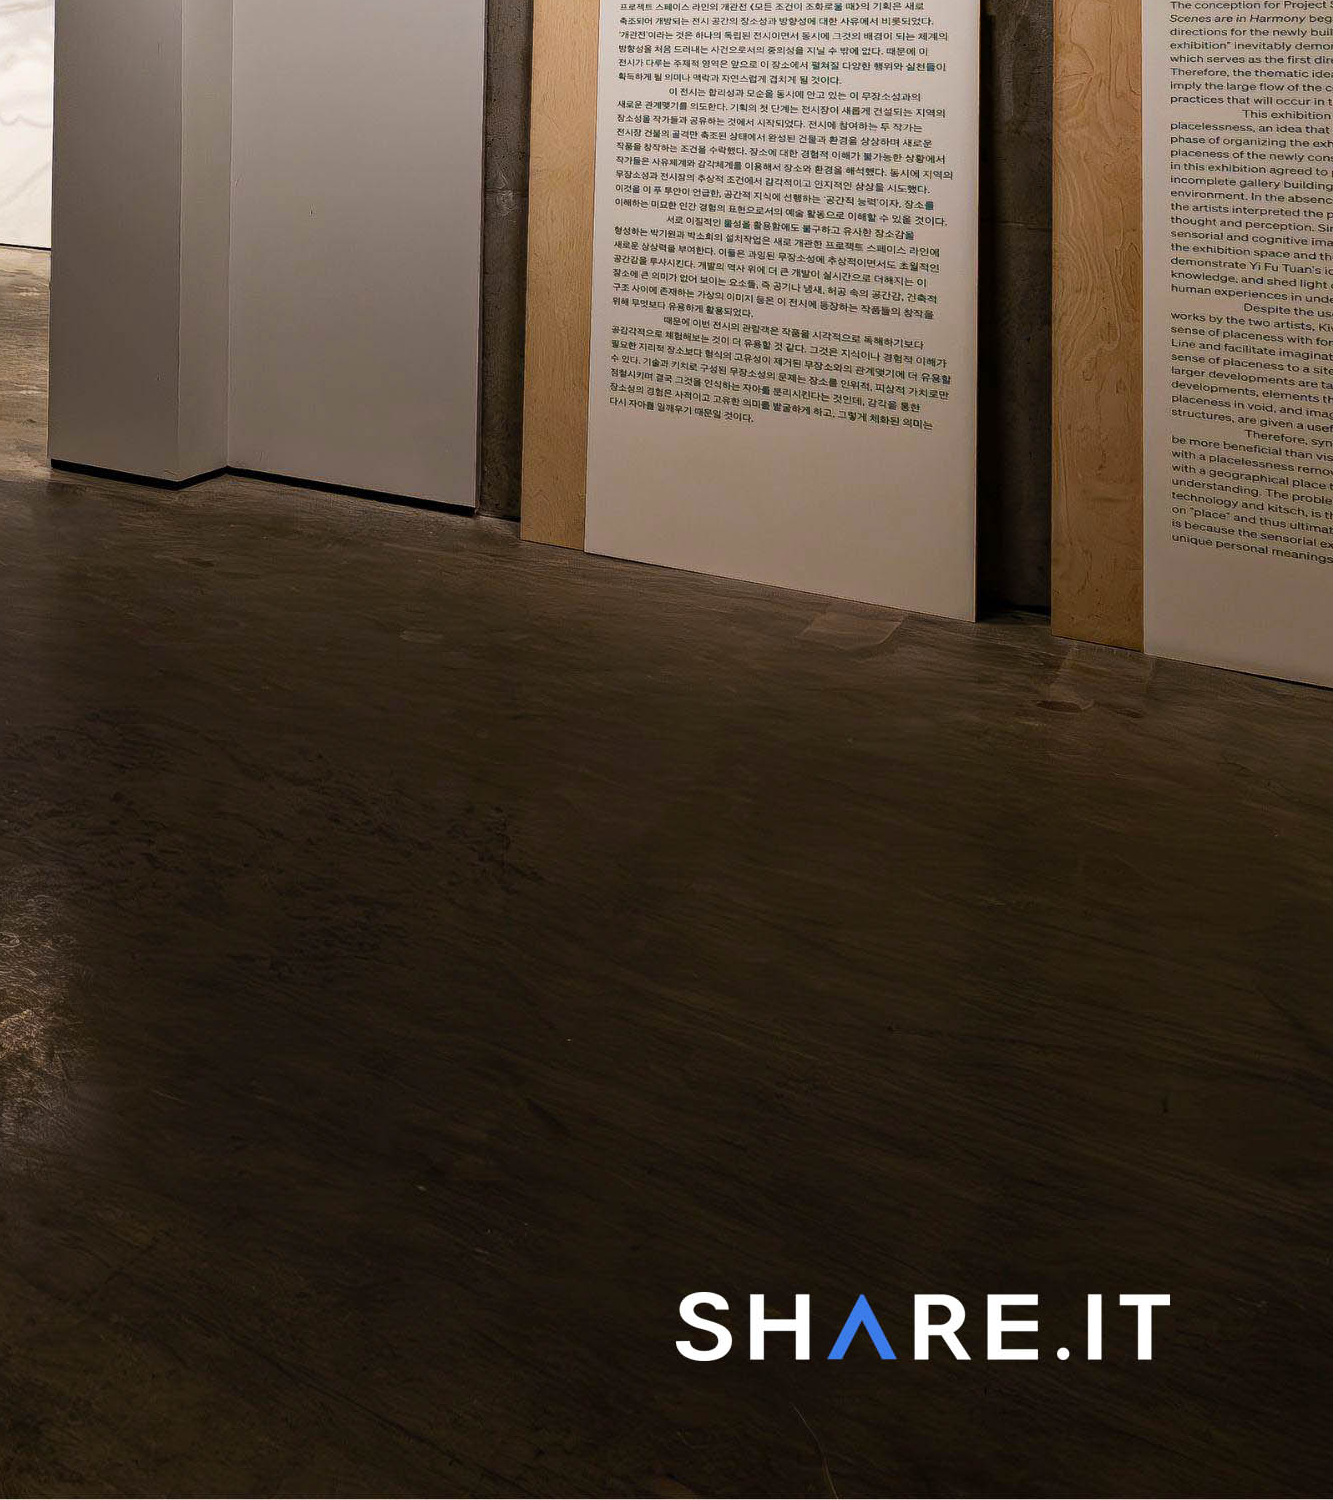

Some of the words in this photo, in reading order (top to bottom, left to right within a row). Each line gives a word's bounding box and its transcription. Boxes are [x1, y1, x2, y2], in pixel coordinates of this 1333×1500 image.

[619, 3, 652, 11] 프로젝트
[655, 3, 689, 11] 스페이스
[691, 3, 718, 11] 라인의
[720, 3, 747, 11] 개관전
[775, 3, 802, 11] 조건이
[872, 2, 902, 11] 기획은
[904, 2, 924, 11] 새로
[1170, 0, 1192, 9] The
[1194, 0, 1260, 11] conception
[1263, 0, 1280, 8] for
[1283, 0, 1327, 11] Project
[619, 17, 652, 25] 축조되어
[655, 17, 689, 26] 개방되는
[691, 17, 709, 26] 전시
[711, 17, 737, 26] 공간의
[740, 17, 777, 26] 장소성과
[778, 17, 816, 26] 방향성에
[818, 17, 837, 26] 대한
[879, 17, 933, 26] 비롯되었다.
[1170, 14, 1212, 22] Scenes
[1235, 14, 1246, 22] in
[1249, 14, 1306, 25] Harmony
[675, 31, 693, 40] 것은
[695, 31, 721, 40] 하나의
[723, 31, 750, 40] 독립된
[753, 32, 799, 40] 전시이면서
[801, 32, 829, 40] 동시에
[832, 32, 861, 40] 그것의
[895, 32, 915, 41] 되는
[917, 32, 947, 41] 체계의
[1170, 27, 1227, 36] directions
[1230, 27, 1247, 36] for
[1249, 27, 1269, 36] the
[1272, 27, 1307, 38] newly
[618, 45, 652, 53] 방향성을
[654, 45, 671, 54] 처음
[673, 45, 708, 54] 드러내는
[710, 45, 764, 54] 사건으로서의
[767, 46, 803, 54] 중의성을
[806, 46, 825, 55] 지닐
[827, 46, 837, 55] 수
[839, 46, 859, 55] 밖에
[861, 47, 883, 55] 없다.
[885, 47, 915, 55] 때문에
[918, 47, 927, 55] 이
[1234, 41, 1292, 52] inevitably
[1170, 54, 1203, 63] which
[1264, 55, 1284, 63] the
[1287, 55, 1311, 63] first
[618, 59, 644, 67] 전시가
[645, 59, 671, 68] 다루는
[673, 59, 699, 68] 주제적
[701, 60, 728, 68] 영역은
[730, 60, 757, 69] 앞으로
[760, 60, 769, 69] 이
[771, 61, 808, 69] 장소에서
[842, 61, 871, 70] 다양한
[905, 62, 946, 71] 실천들이
[1170, 67, 1229, 78] Therefore,
[1232, 68, 1251, 76] the
[1253, 68, 1309, 77] thematic
[1170, 81, 1202, 92] imply
[1204, 82, 1225, 90] the
[1226, 82, 1256, 93] large
[1259, 82, 1284, 91] flow
[1286, 83, 1299, 91] of
[1302, 83, 1322, 91] the
[1170, 95, 1224, 105] practices
[1226, 96, 1250, 104] that
[1253, 96, 1275, 105] will
[1313, 97, 1324, 105] in
[1242, 109, 1267, 118] This
[1270, 110, 1331, 119] exhibition
[1170, 121, 1258, 132] placelessness,
[1275, 123, 1302, 132] idea
[1305, 124, 1330, 133] that
[1170, 135, 1205, 145] phase
[1207, 136, 1220, 144] of
[1222, 137, 1286, 148] organizing
[1289, 138, 1309, 146] the
[1170, 148, 1231, 159] placeness
[1232, 150, 1245, 158] of
[1246, 150, 1266, 159] the
[1269, 151, 1304, 162] newly
[1170, 161, 1180, 170] in
[1183, 162, 1207, 171] this
[1207, 163, 1268, 173] exhibition
[1269, 167, 1312, 177] agreed
[1315, 168, 1328, 176] to
[1170, 175, 1236, 187] incomplete
[1239, 178, 1283, 190] gallery
[1170, 189, 1248, 200] environment.
[1251, 192, 1261, 200] In
[1265, 192, 1287, 201] the
[1171, 435, 1188, 445] be
[1189, 439, 1222, 448] more
[1223, 441, 1282, 455] beneficial
[1283, 448, 1312, 458] than
[1171, 450, 1198, 460] with
[1209, 454, 1294, 471] placelessness
[1171, 464, 1196, 474] with
[1206, 469, 1289, 485] geographical
[1289, 478, 1326, 489] place
[1171, 478, 1263, 498] understanding.
[1267, 489, 1291, 499] The
[1171, 491, 1238, 509] technology
[1241, 501, 1264, 510] and
[1267, 503, 1310, 517] kitsch,
[1311, 508, 1321, 517] is
[1171, 506, 1186, 515] on
[1233, 515, 1256, 524] and
[1259, 517, 1286, 528] thus
[1171, 518, 1181, 528] is
[1184, 520, 1235, 535] because
[1236, 528, 1257, 538] the
[1257, 532, 1317, 546] sensorial
[1171, 534, 1213, 546] unique
[1215, 540, 1271, 554] personal
